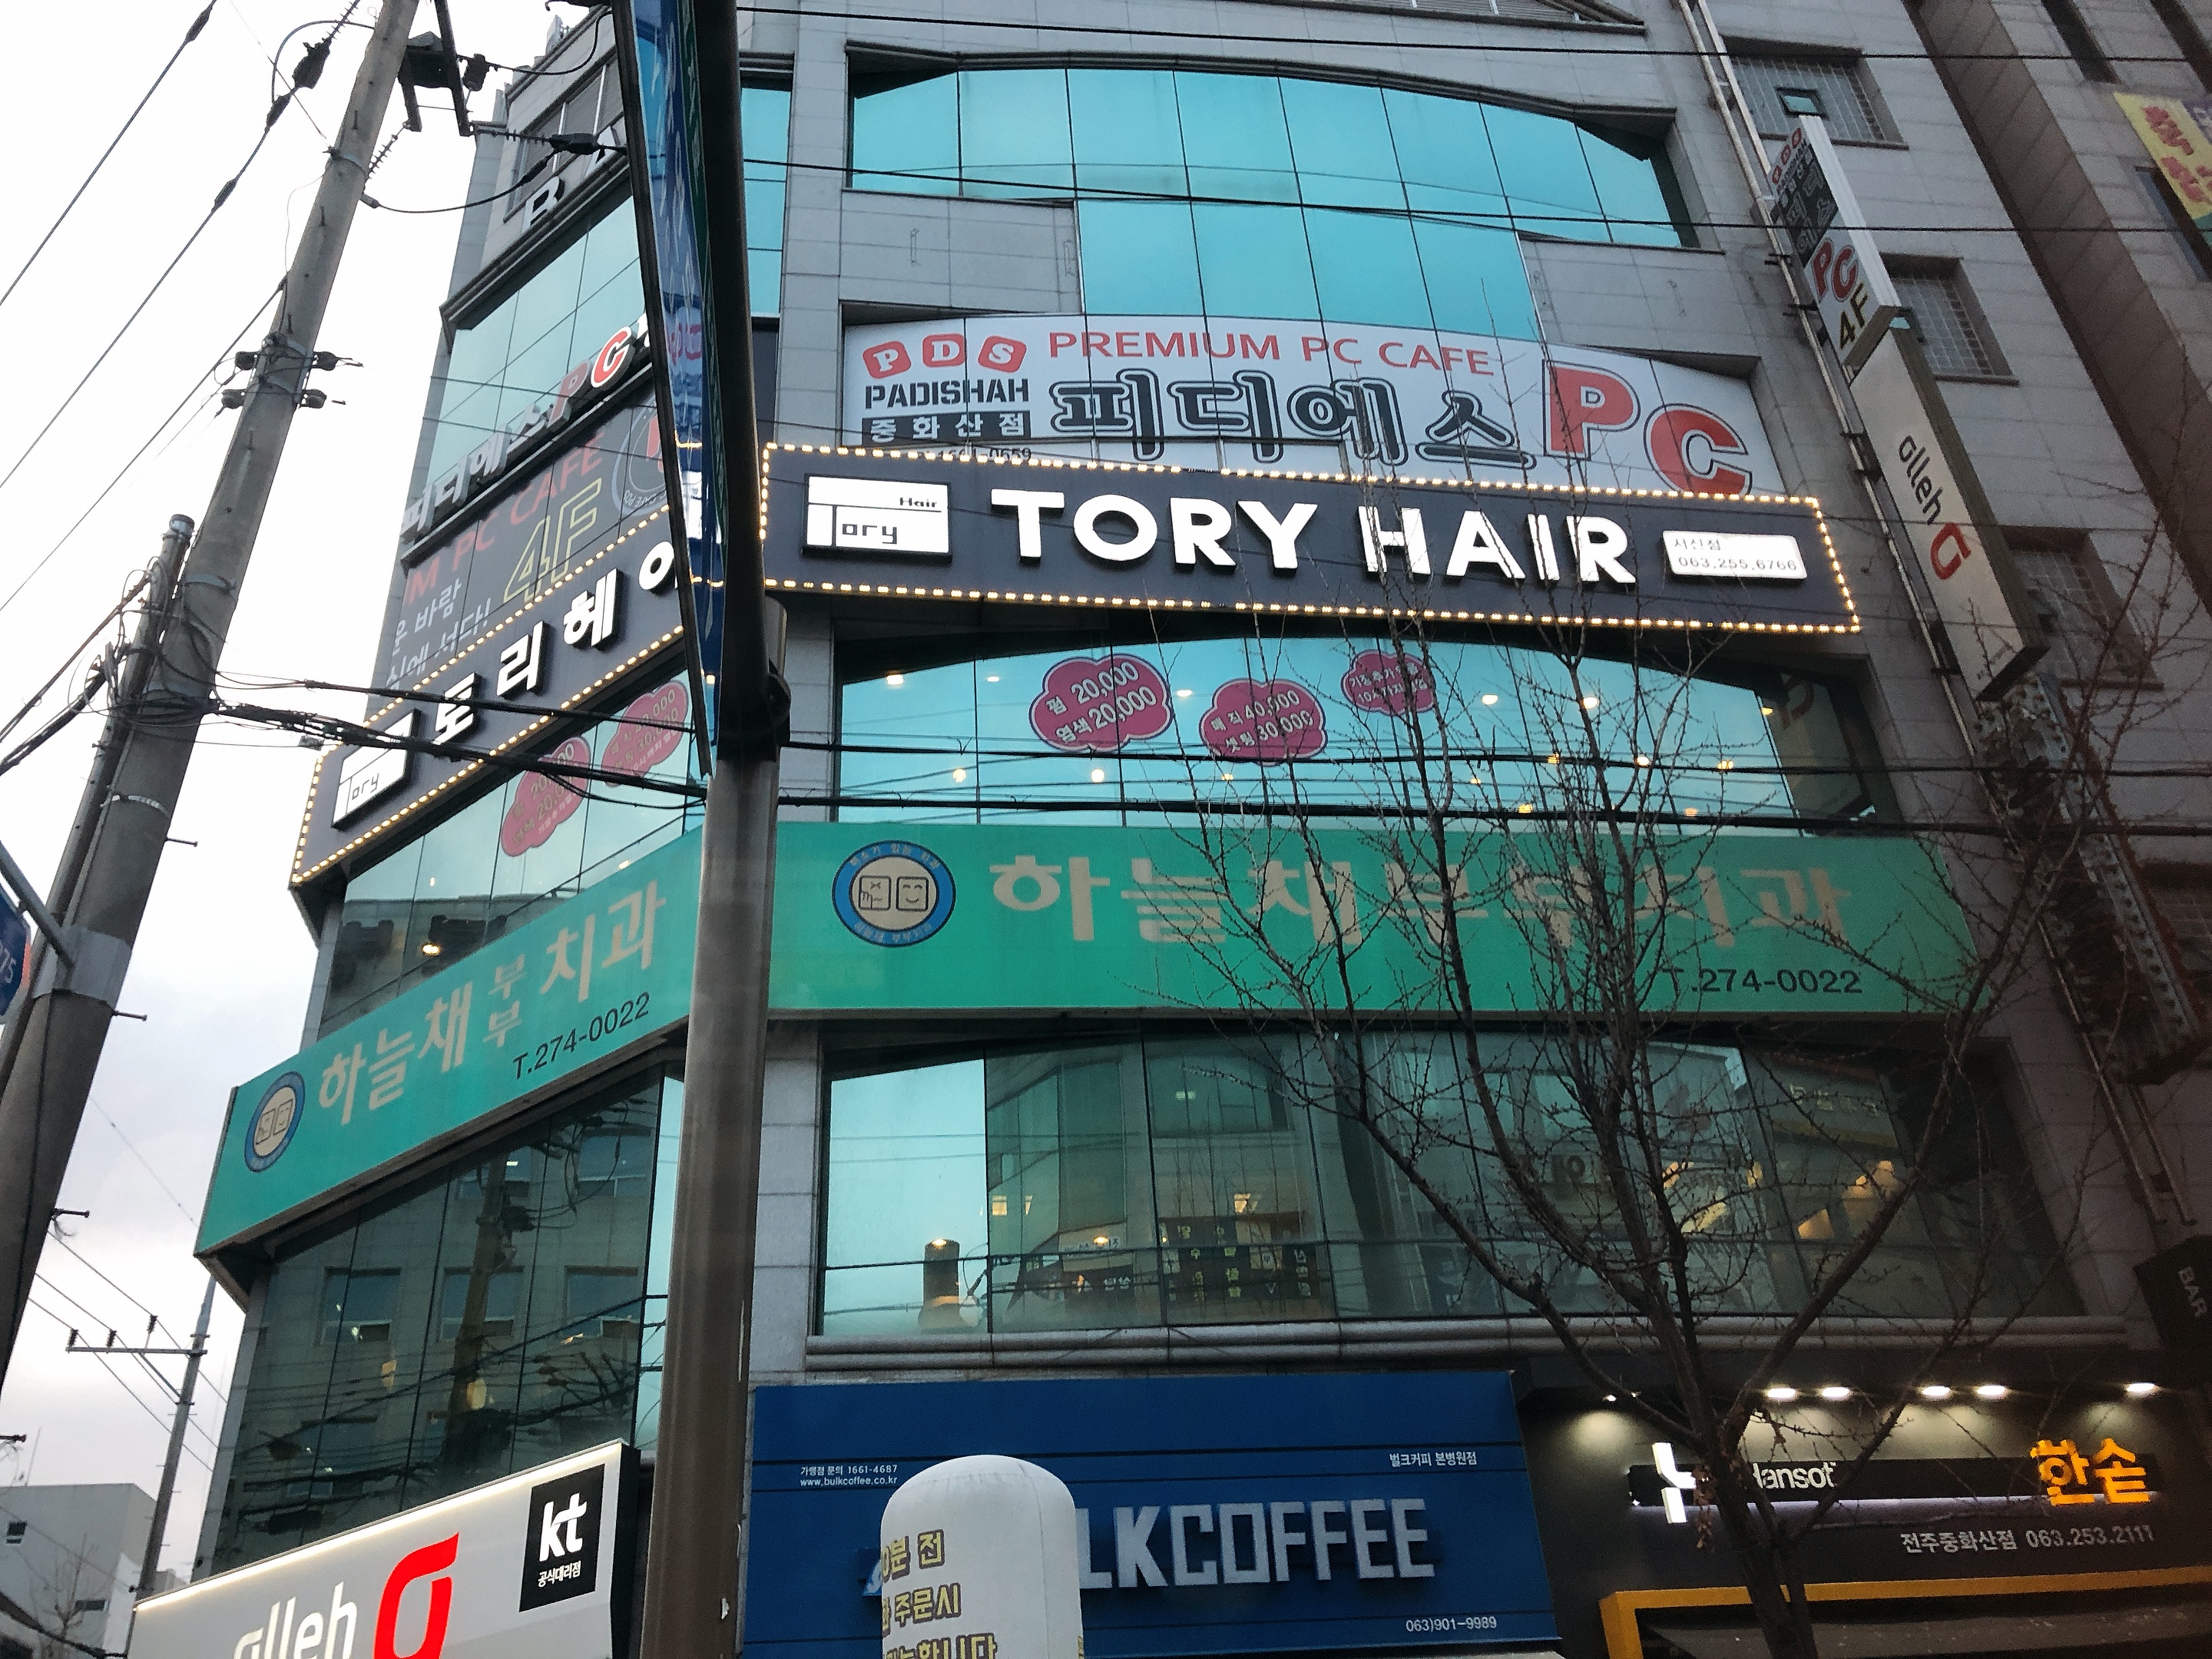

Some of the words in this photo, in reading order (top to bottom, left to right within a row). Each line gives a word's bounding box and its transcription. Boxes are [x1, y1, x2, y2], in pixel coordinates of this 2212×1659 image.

[1810, 239, 1859, 303] PC
[1840, 283, 1869, 349] 4F
[1049, 332, 1280, 360] PREMIUM
[1303, 336, 1363, 364] PC
[1379, 343, 1495, 376] CAFE
[865, 378, 1030, 409] PADISHAH
[870, 413, 1025, 443] 중화산점
[1048, 368, 1537, 470] 피디에스
[1542, 359, 1753, 495] PC
[510, 431, 605, 525] CAFE
[899, 497, 938, 508] Hair
[503, 476, 602, 604] 4F
[991, 488, 1319, 570] TORY
[1358, 506, 1637, 584] HAIR
[1678, 557, 1797, 571] 063.255.6766
[414, 578, 462, 634] 바람
[1071, 661, 1139, 704] 20,000
[1055, 717, 1093, 743] 염색
[1088, 686, 1157, 729] 20,000
[1244, 690, 1300, 720] 40,000
[319, 982, 473, 1125] 하늘채
[540, 880, 667, 1002] 치과
[1662, 968, 1863, 994] T.274-0022
[512, 992, 651, 1080] T.274-0022
[2178, 1267, 2207, 1318] BAR
[800, 1466, 826, 1475] 가맹점
[827, 1465, 843, 1475] 문의
[848, 1465, 898, 1475] 1661-4687
[800, 1476, 898, 1487] www.bulkcoffee.co.kr
[1389, 1452, 1432, 1468] 벌크커피
[539, 1492, 588, 1562] kt
[1900, 1530, 2018, 1554] 전주중화산점
[2025, 1525, 2154, 1549] 063.253.2111
[918, 1529, 945, 1569] 전
[538, 1560, 581, 1588] 공식대리점
[894, 1582, 962, 1627] 주문시
[1406, 1616, 1497, 1632] 063)901-9989
